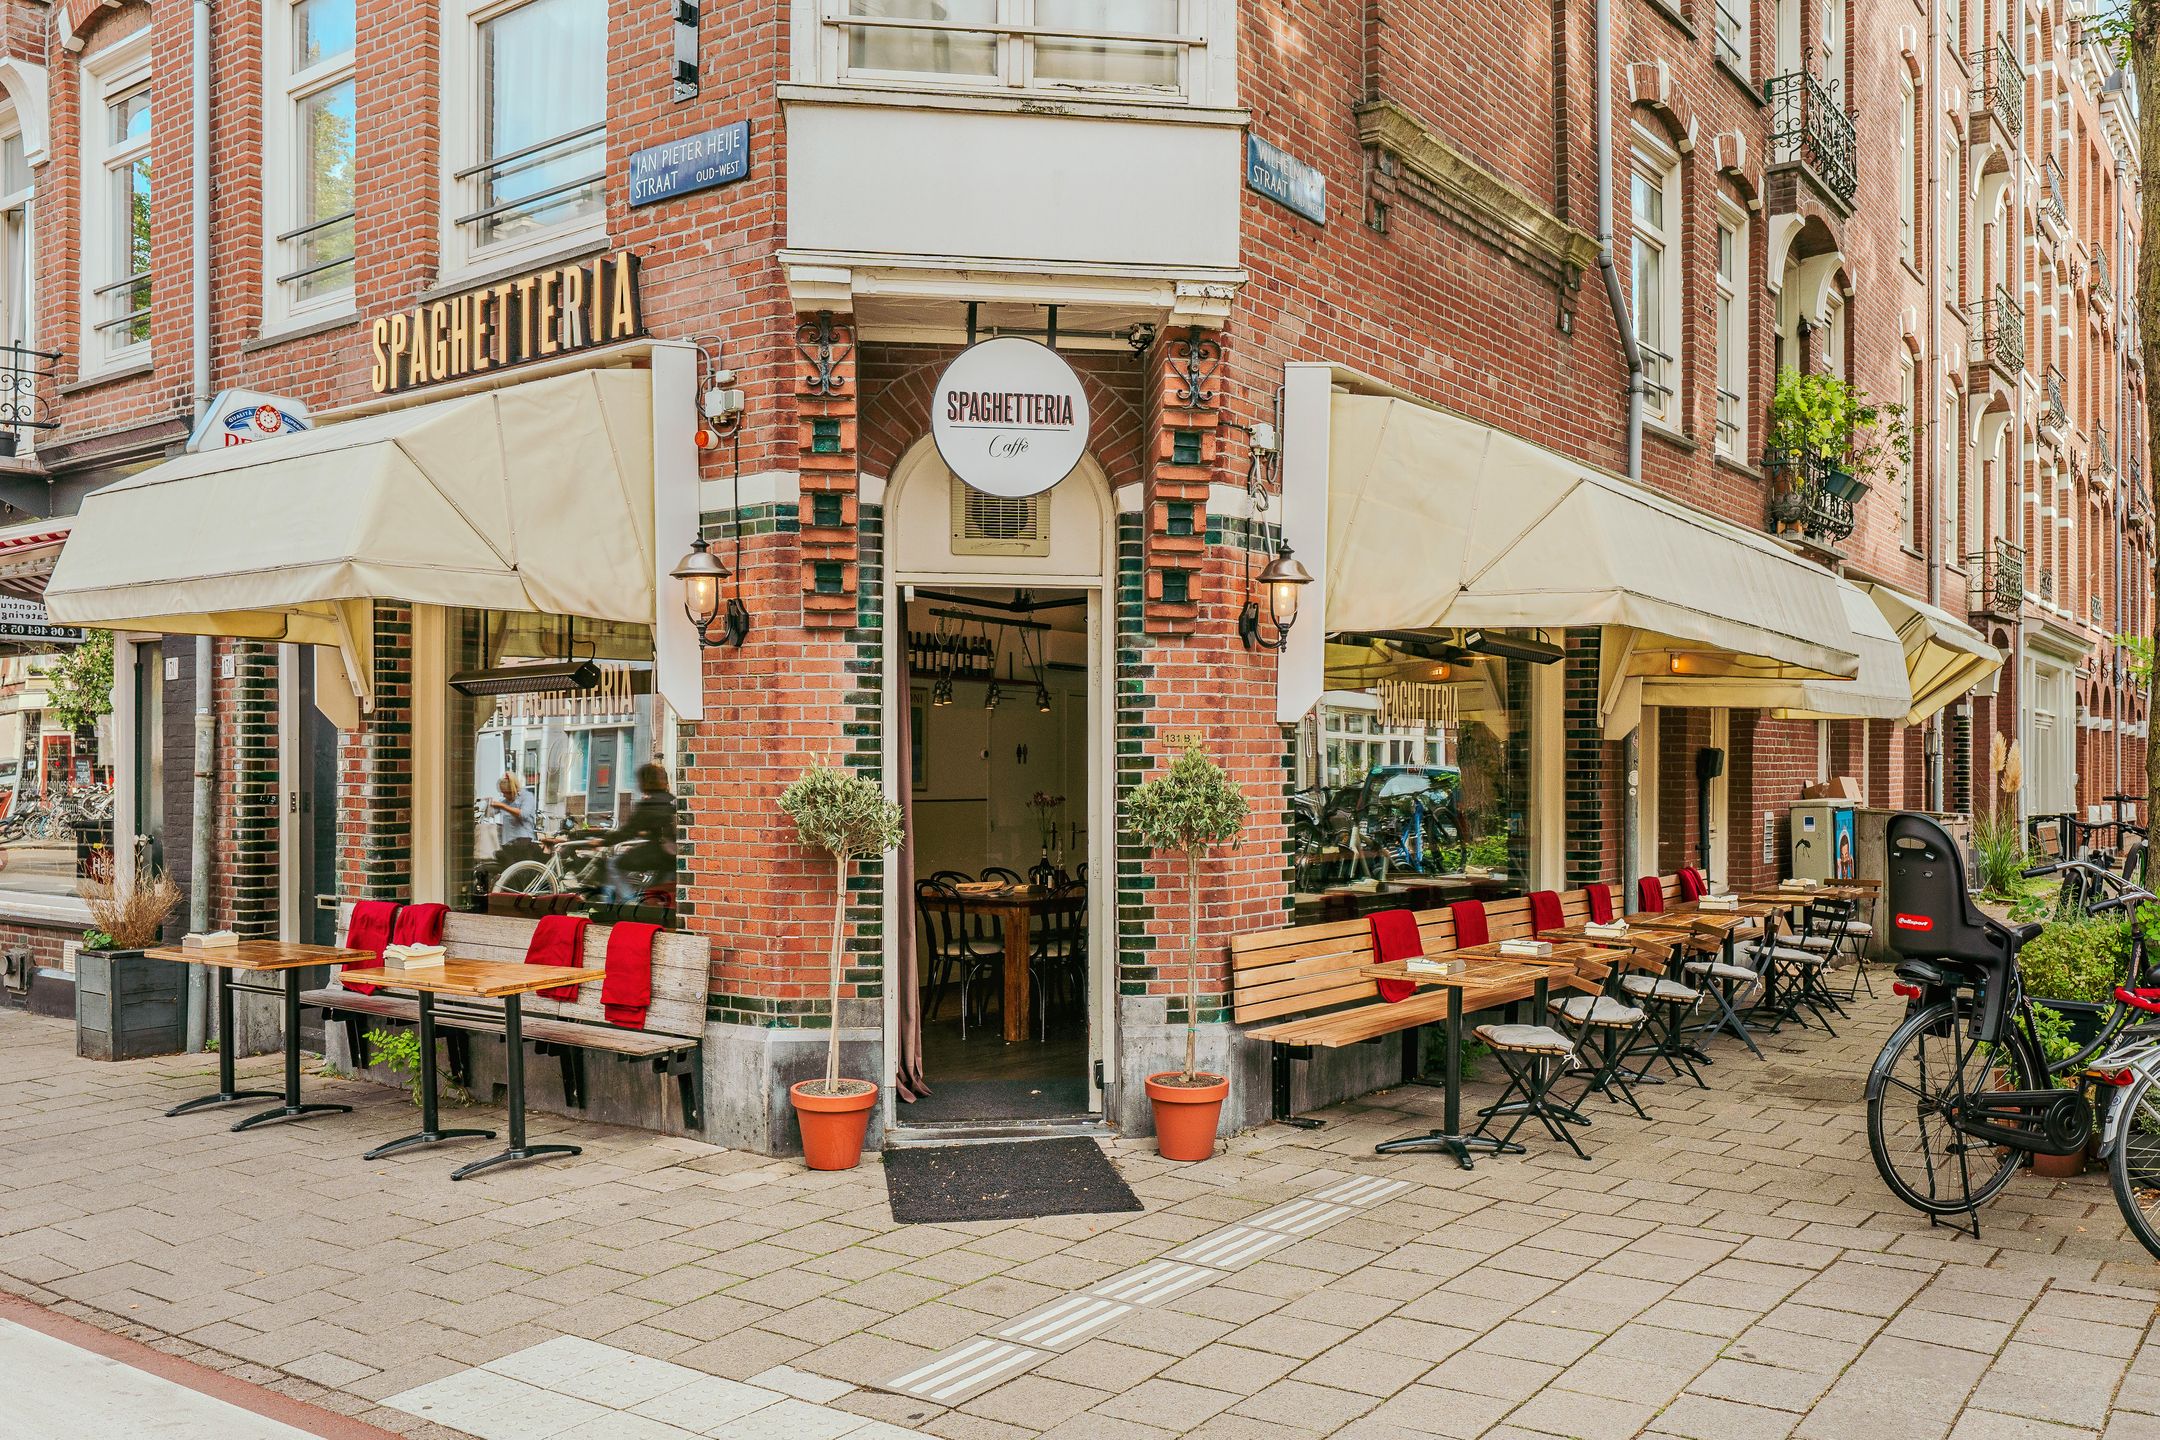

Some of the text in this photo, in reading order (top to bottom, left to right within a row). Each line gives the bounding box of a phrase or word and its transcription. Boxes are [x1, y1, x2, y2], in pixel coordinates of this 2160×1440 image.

[636, 129, 740, 180] JAN PIETER HEIJE
[1259, 144, 1320, 188] WILHELM
[635, 160, 740, 199] STRAAT OUD-WEST
[1253, 165, 1322, 216] STRAAT OUDWEST
[372, 251, 637, 393] SPAGHETTERIA
[228, 410, 253, 422] QUALITÀ
[947, 390, 1074, 426] SPAGHETTERIA
[988, 434, 1029, 459] Caffè
[1376, 678, 1459, 729] SPAGHETTERIA
